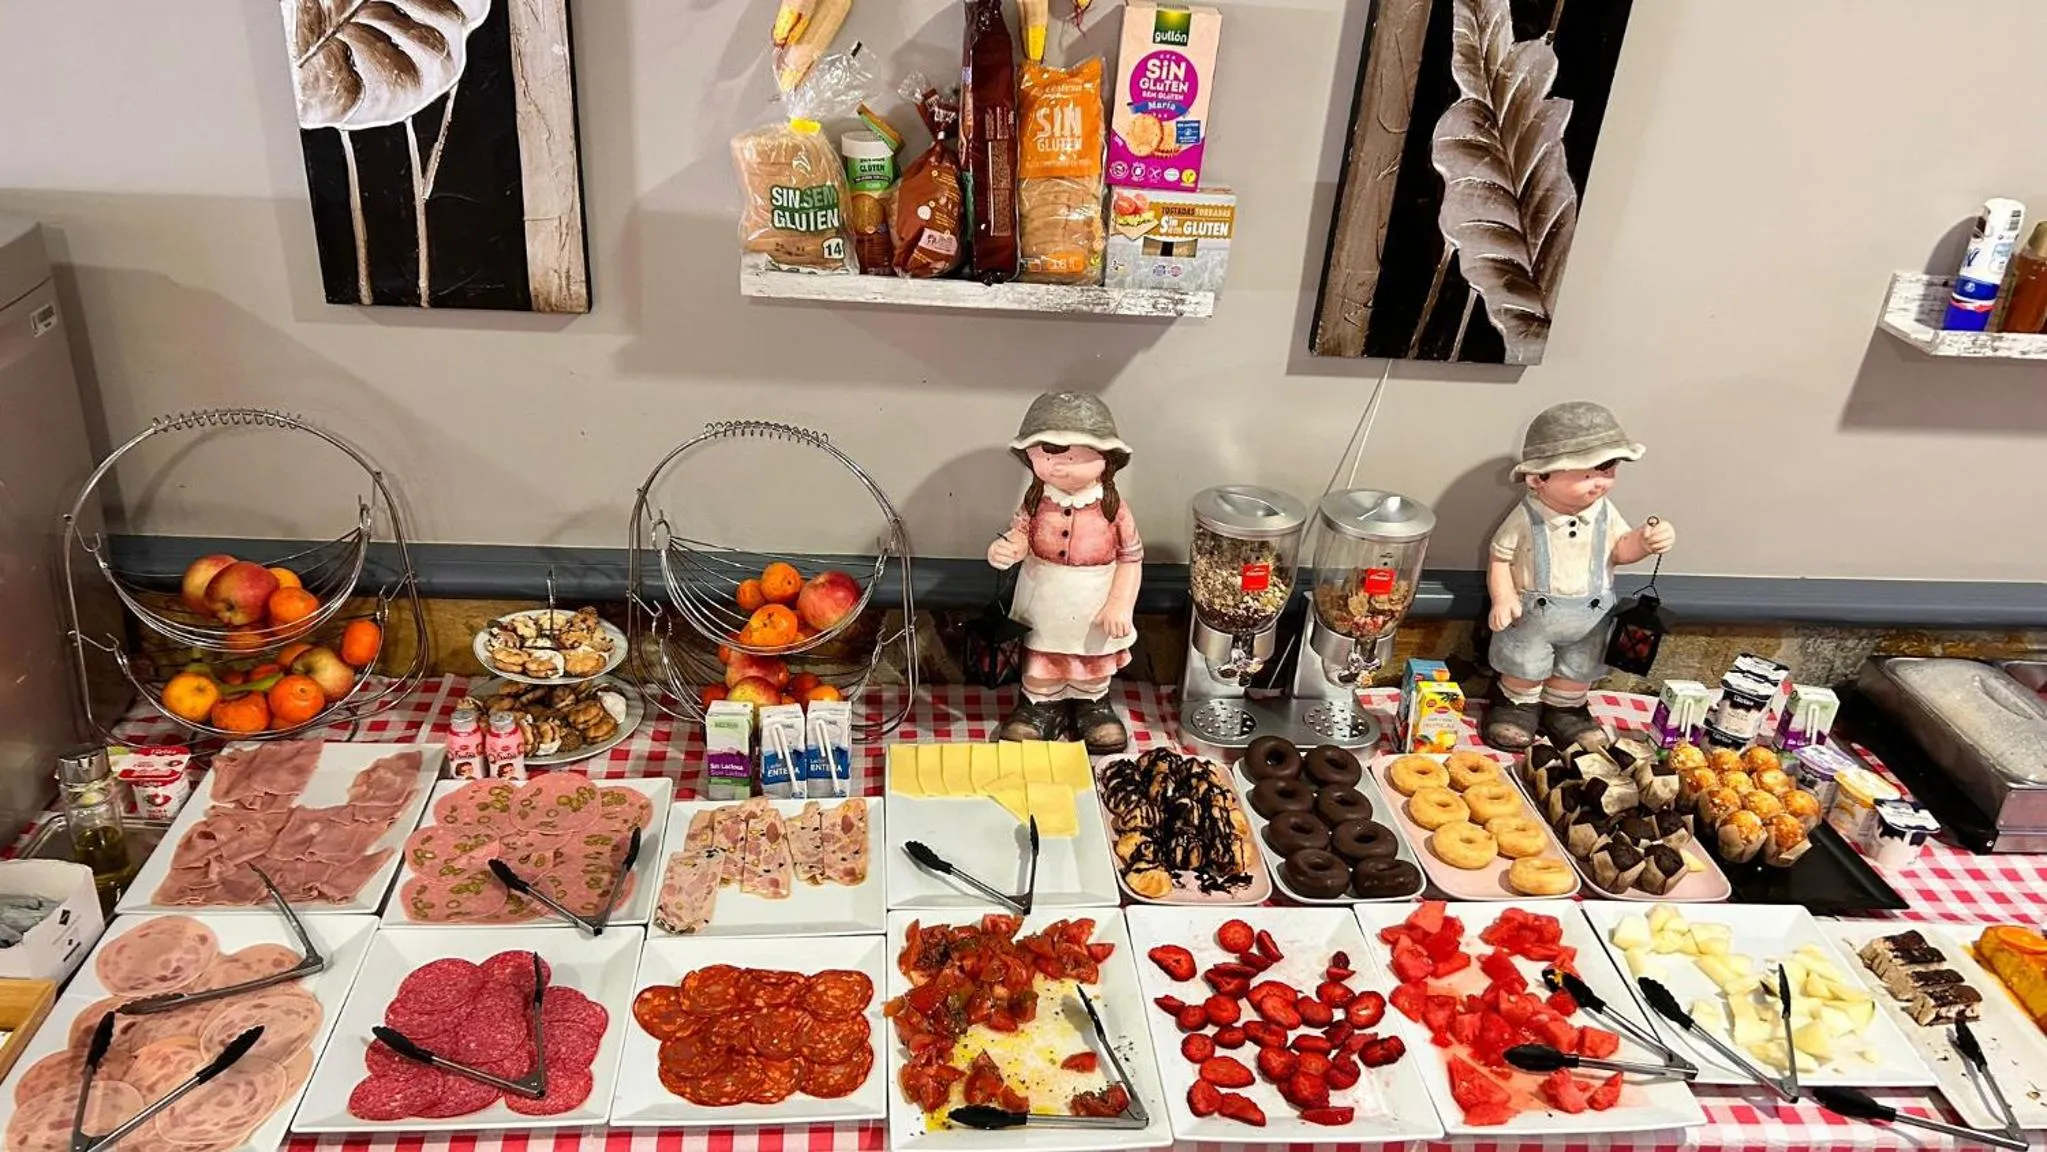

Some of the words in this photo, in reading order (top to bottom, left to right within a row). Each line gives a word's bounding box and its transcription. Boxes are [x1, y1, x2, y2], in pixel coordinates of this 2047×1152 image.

[1155, 30, 1187, 43] gullón
[1036, 105, 1082, 138] SIN
[1036, 138, 1082, 153] GLUTEN
[860, 164, 885, 173] GLUTEN
[772, 186, 800, 209] SIN
[803, 186, 837, 208] SEM
[774, 208, 839, 231] GLUTEN
[1183, 221, 1229, 237] GLUTEN
[825, 242, 842, 256] 14
